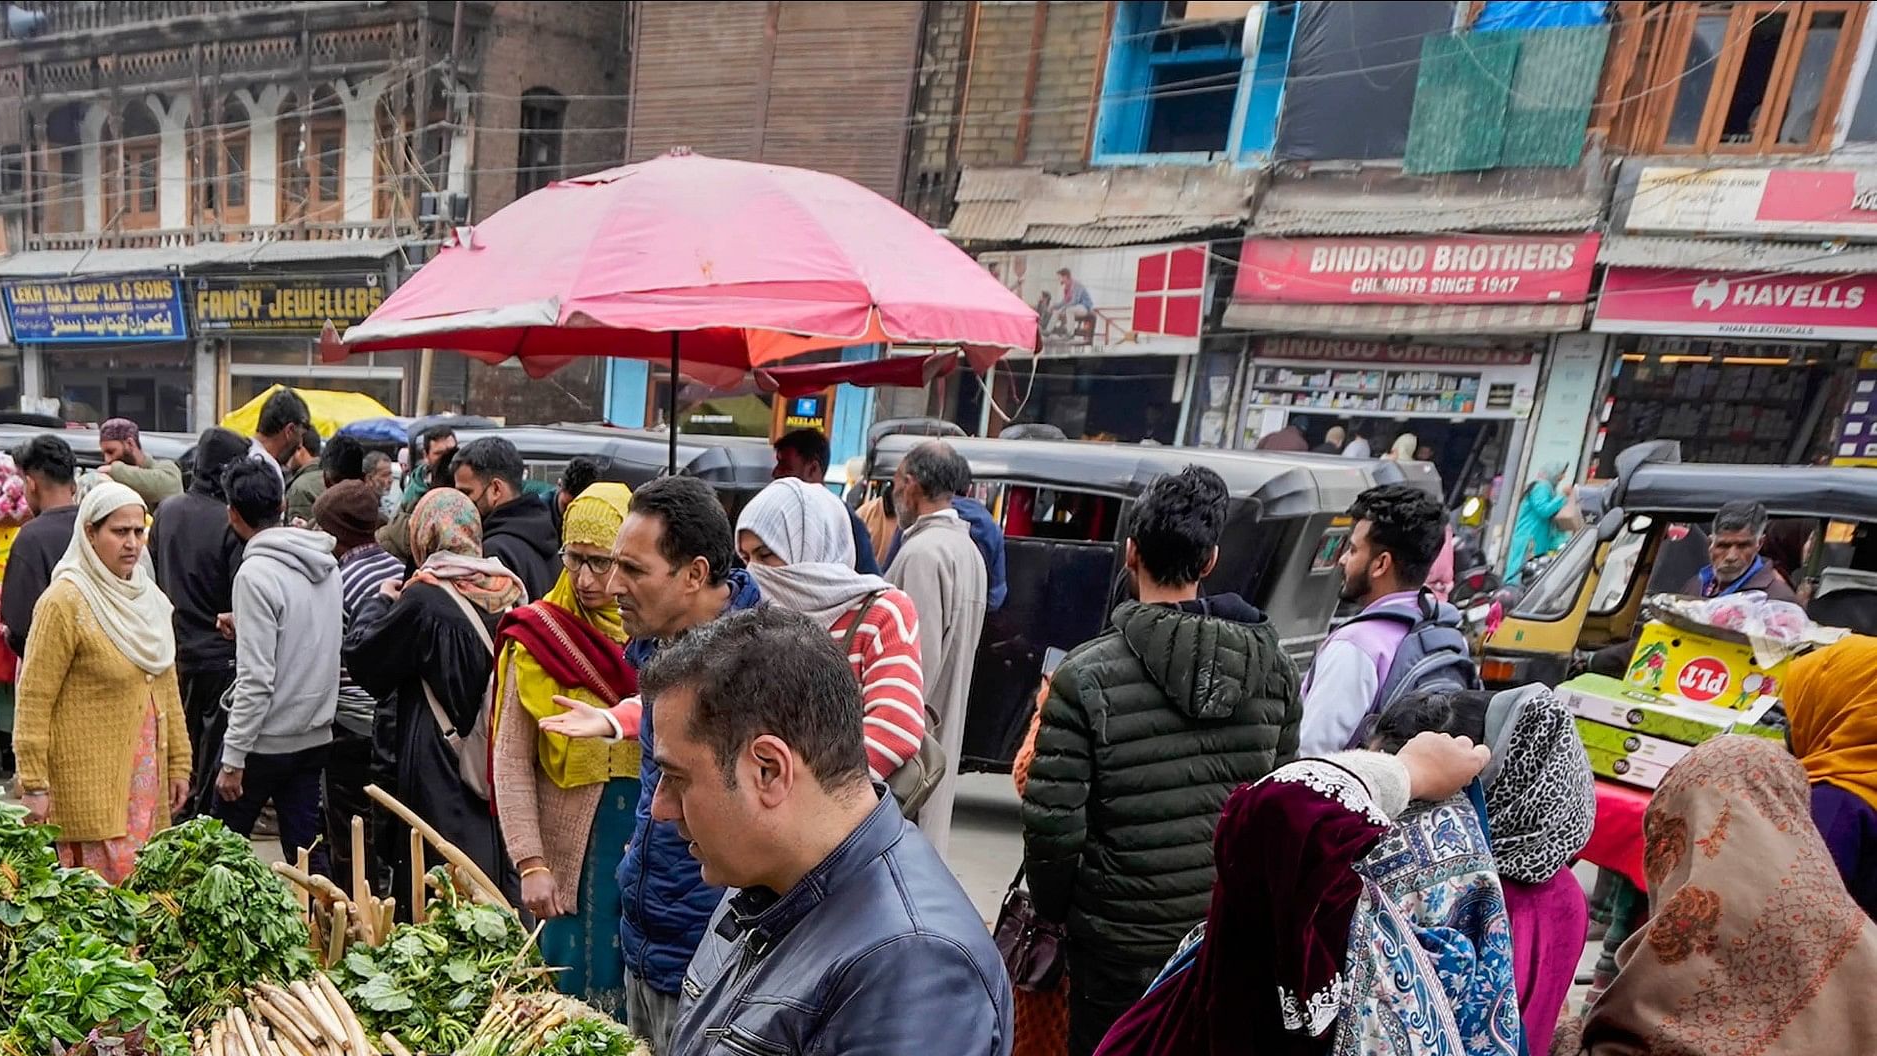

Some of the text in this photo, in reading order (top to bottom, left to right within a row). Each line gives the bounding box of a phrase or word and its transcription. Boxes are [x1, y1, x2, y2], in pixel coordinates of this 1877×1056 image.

[1310, 243, 1576, 273] BINDROO BROTHERS
[9, 285, 43, 304] LEKH
[45, 284, 71, 303] RAJ
[74, 281, 120, 302] GUPTA
[133, 279, 173, 300] SONS
[1430, 276, 1475, 294] SINCE
[1731, 285, 1865, 309] HAVELLS
[197, 287, 384, 319] FANCY JEWELLERS
[1679, 664, 1727, 695] PLT
